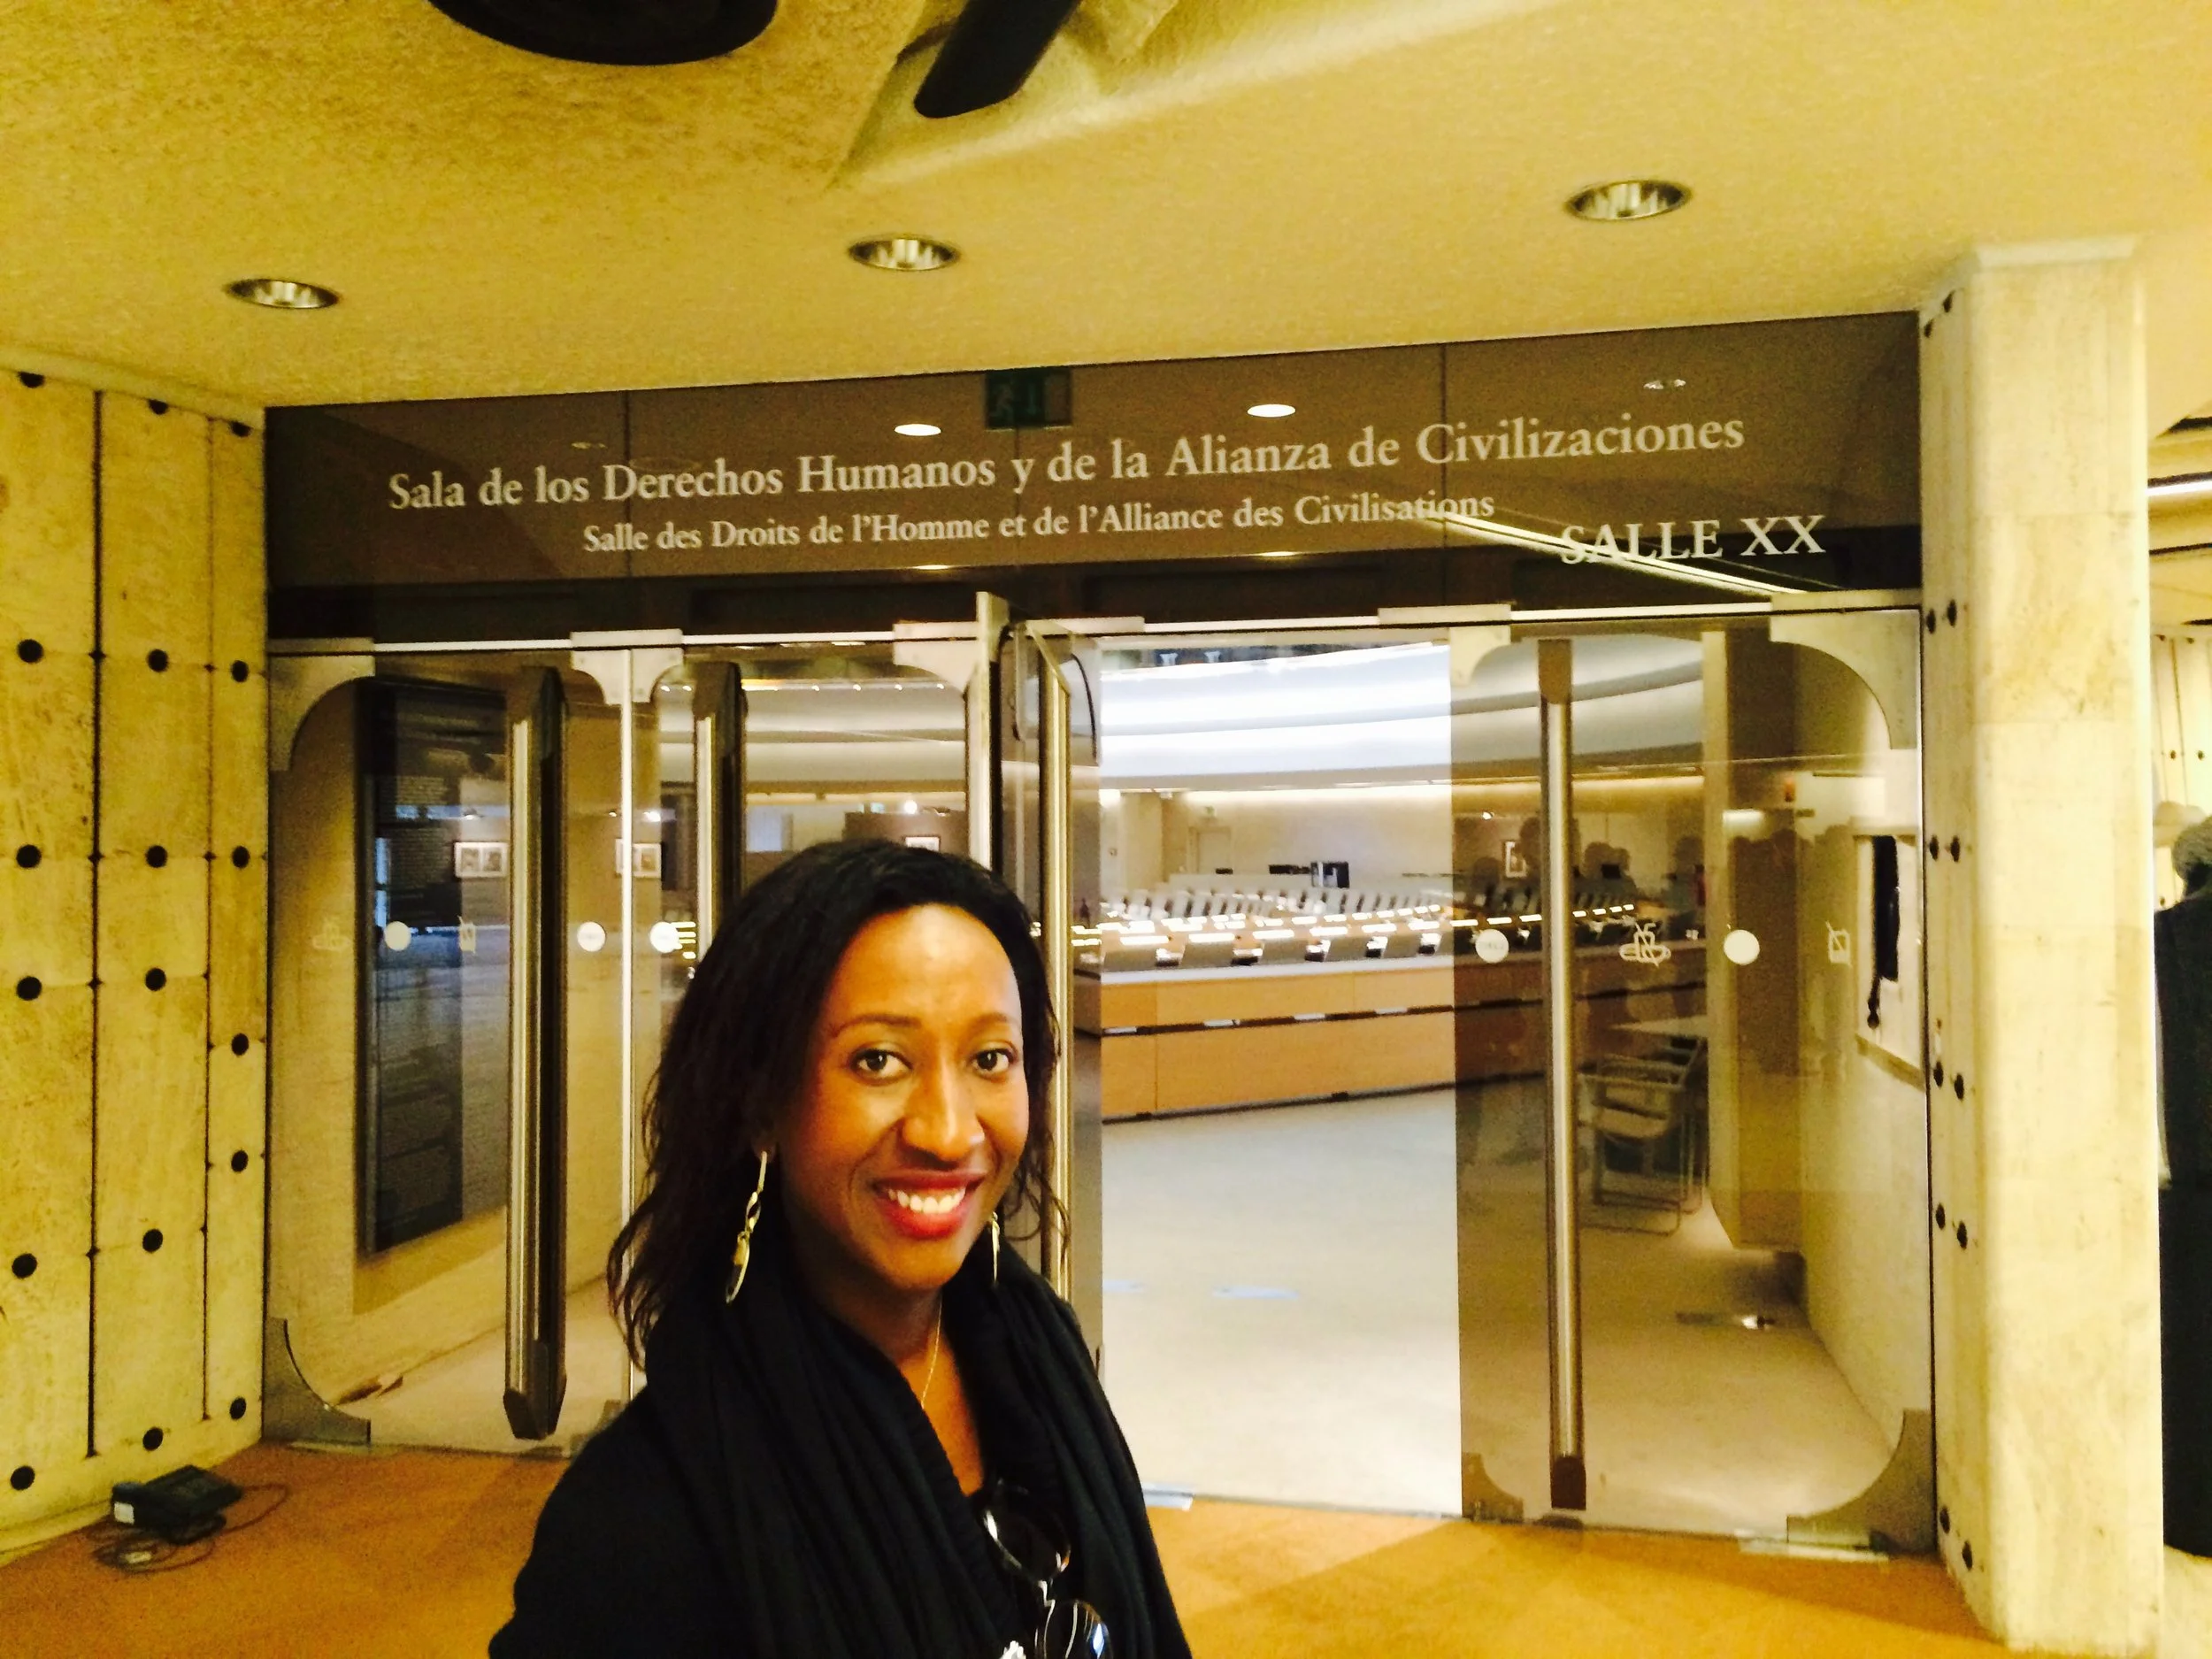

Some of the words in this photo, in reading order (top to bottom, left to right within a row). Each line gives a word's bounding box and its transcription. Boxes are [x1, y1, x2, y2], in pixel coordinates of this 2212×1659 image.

[389, 470, 465, 510] Sala
[479, 467, 524, 506] de
[534, 465, 590, 504] los
[603, 457, 783, 501] Derechos
[798, 454, 996, 492] Humanos
[1011, 457, 1037, 494] y
[1048, 442, 1095, 482] de
[1111, 438, 1149, 479] la
[1165, 434, 1332, 476] Alianza
[1348, 426, 1400, 467] de
[1417, 412, 1746, 464] Civilizaciones
[583, 522, 648, 553] Salle
[657, 520, 703, 550] des
[711, 518, 801, 549] Droits
[810, 516, 843, 544] de
[999, 515, 1027, 538] et
[1033, 507, 1069, 536] de
[1233, 496, 1285, 528] des
[1294, 490, 1495, 525] Civilisations
[1560, 520, 1724, 565] SALLE
[1740, 515, 1826, 556] XX
